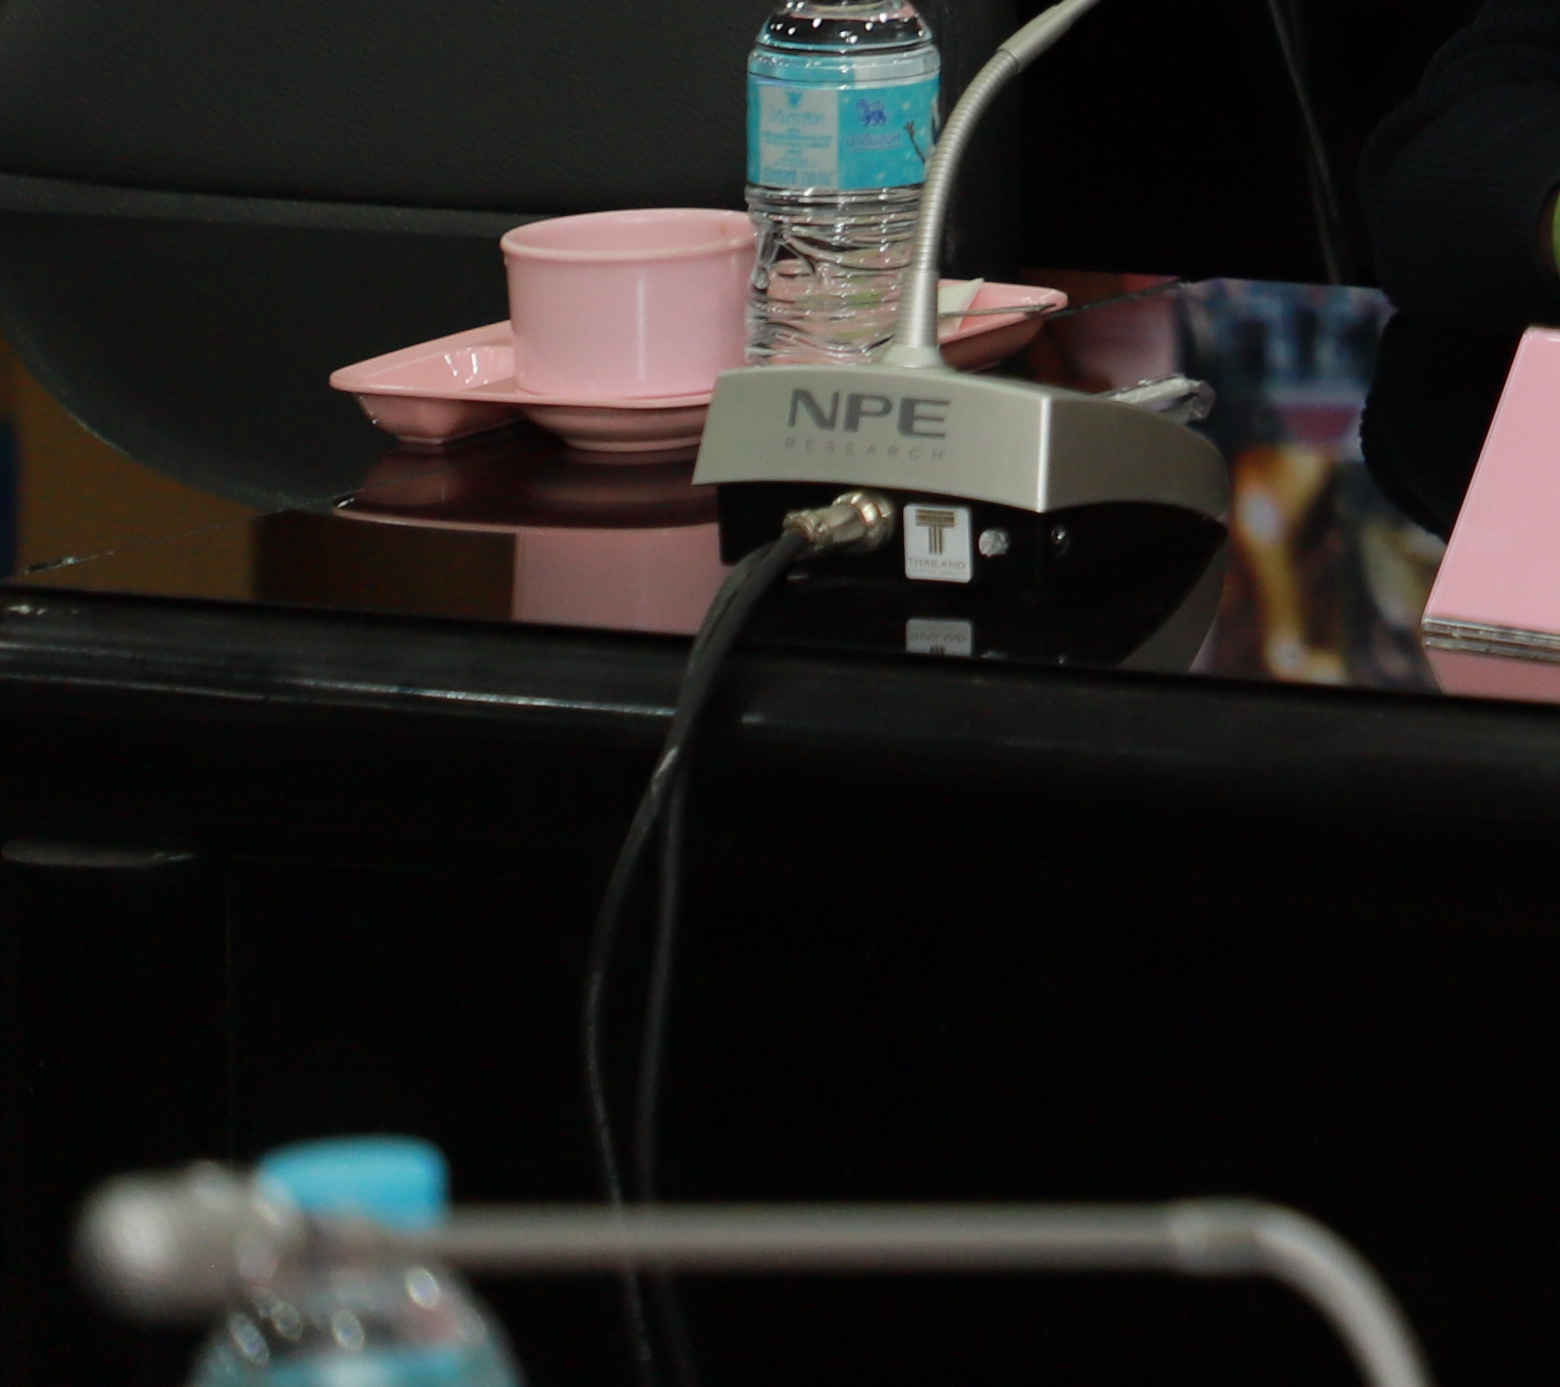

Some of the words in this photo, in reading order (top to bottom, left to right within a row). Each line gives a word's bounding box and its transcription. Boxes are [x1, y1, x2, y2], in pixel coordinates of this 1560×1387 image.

[788, 387, 951, 440] NPE
[784, 436, 945, 462] RESEARCH
[907, 558, 966, 571] THAILAND
